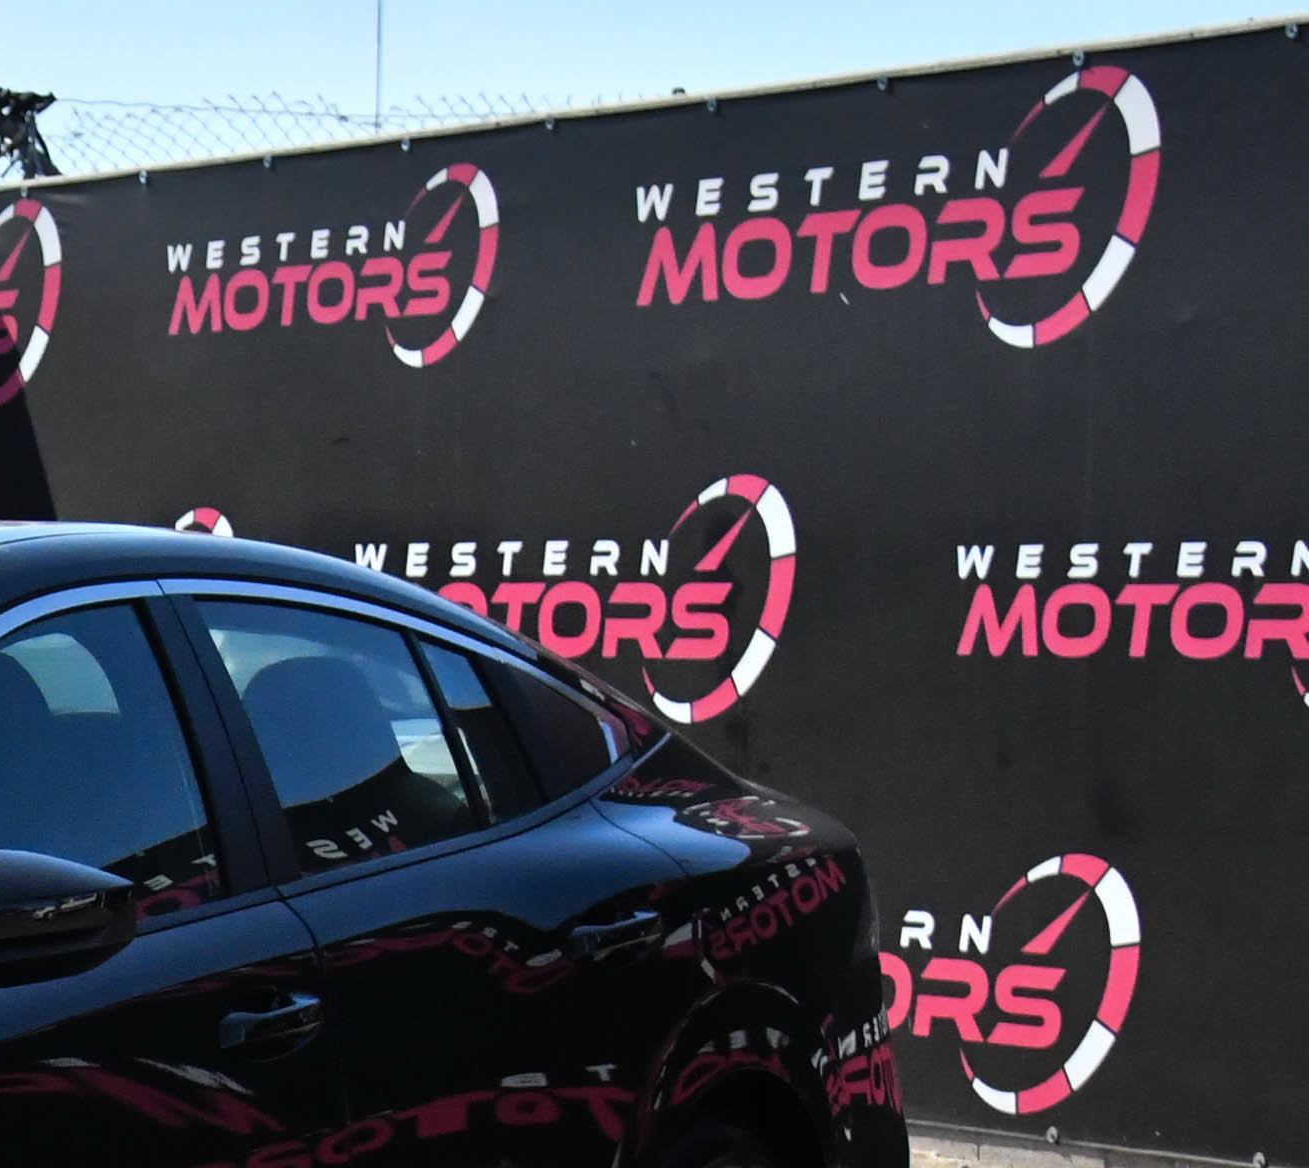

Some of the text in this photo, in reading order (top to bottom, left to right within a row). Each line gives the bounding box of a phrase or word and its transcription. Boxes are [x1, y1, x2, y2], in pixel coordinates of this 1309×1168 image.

[635, 147, 1010, 223] WESTERN
[167, 220, 406, 273] WESTERN
[636, 187, 1085, 307] MOTORS
[168, 250, 453, 336] MOTORS
[353, 538, 670, 578] WESTERN
[956, 582, 1309, 660] MOTOR
[899, 910, 993, 954] RN
